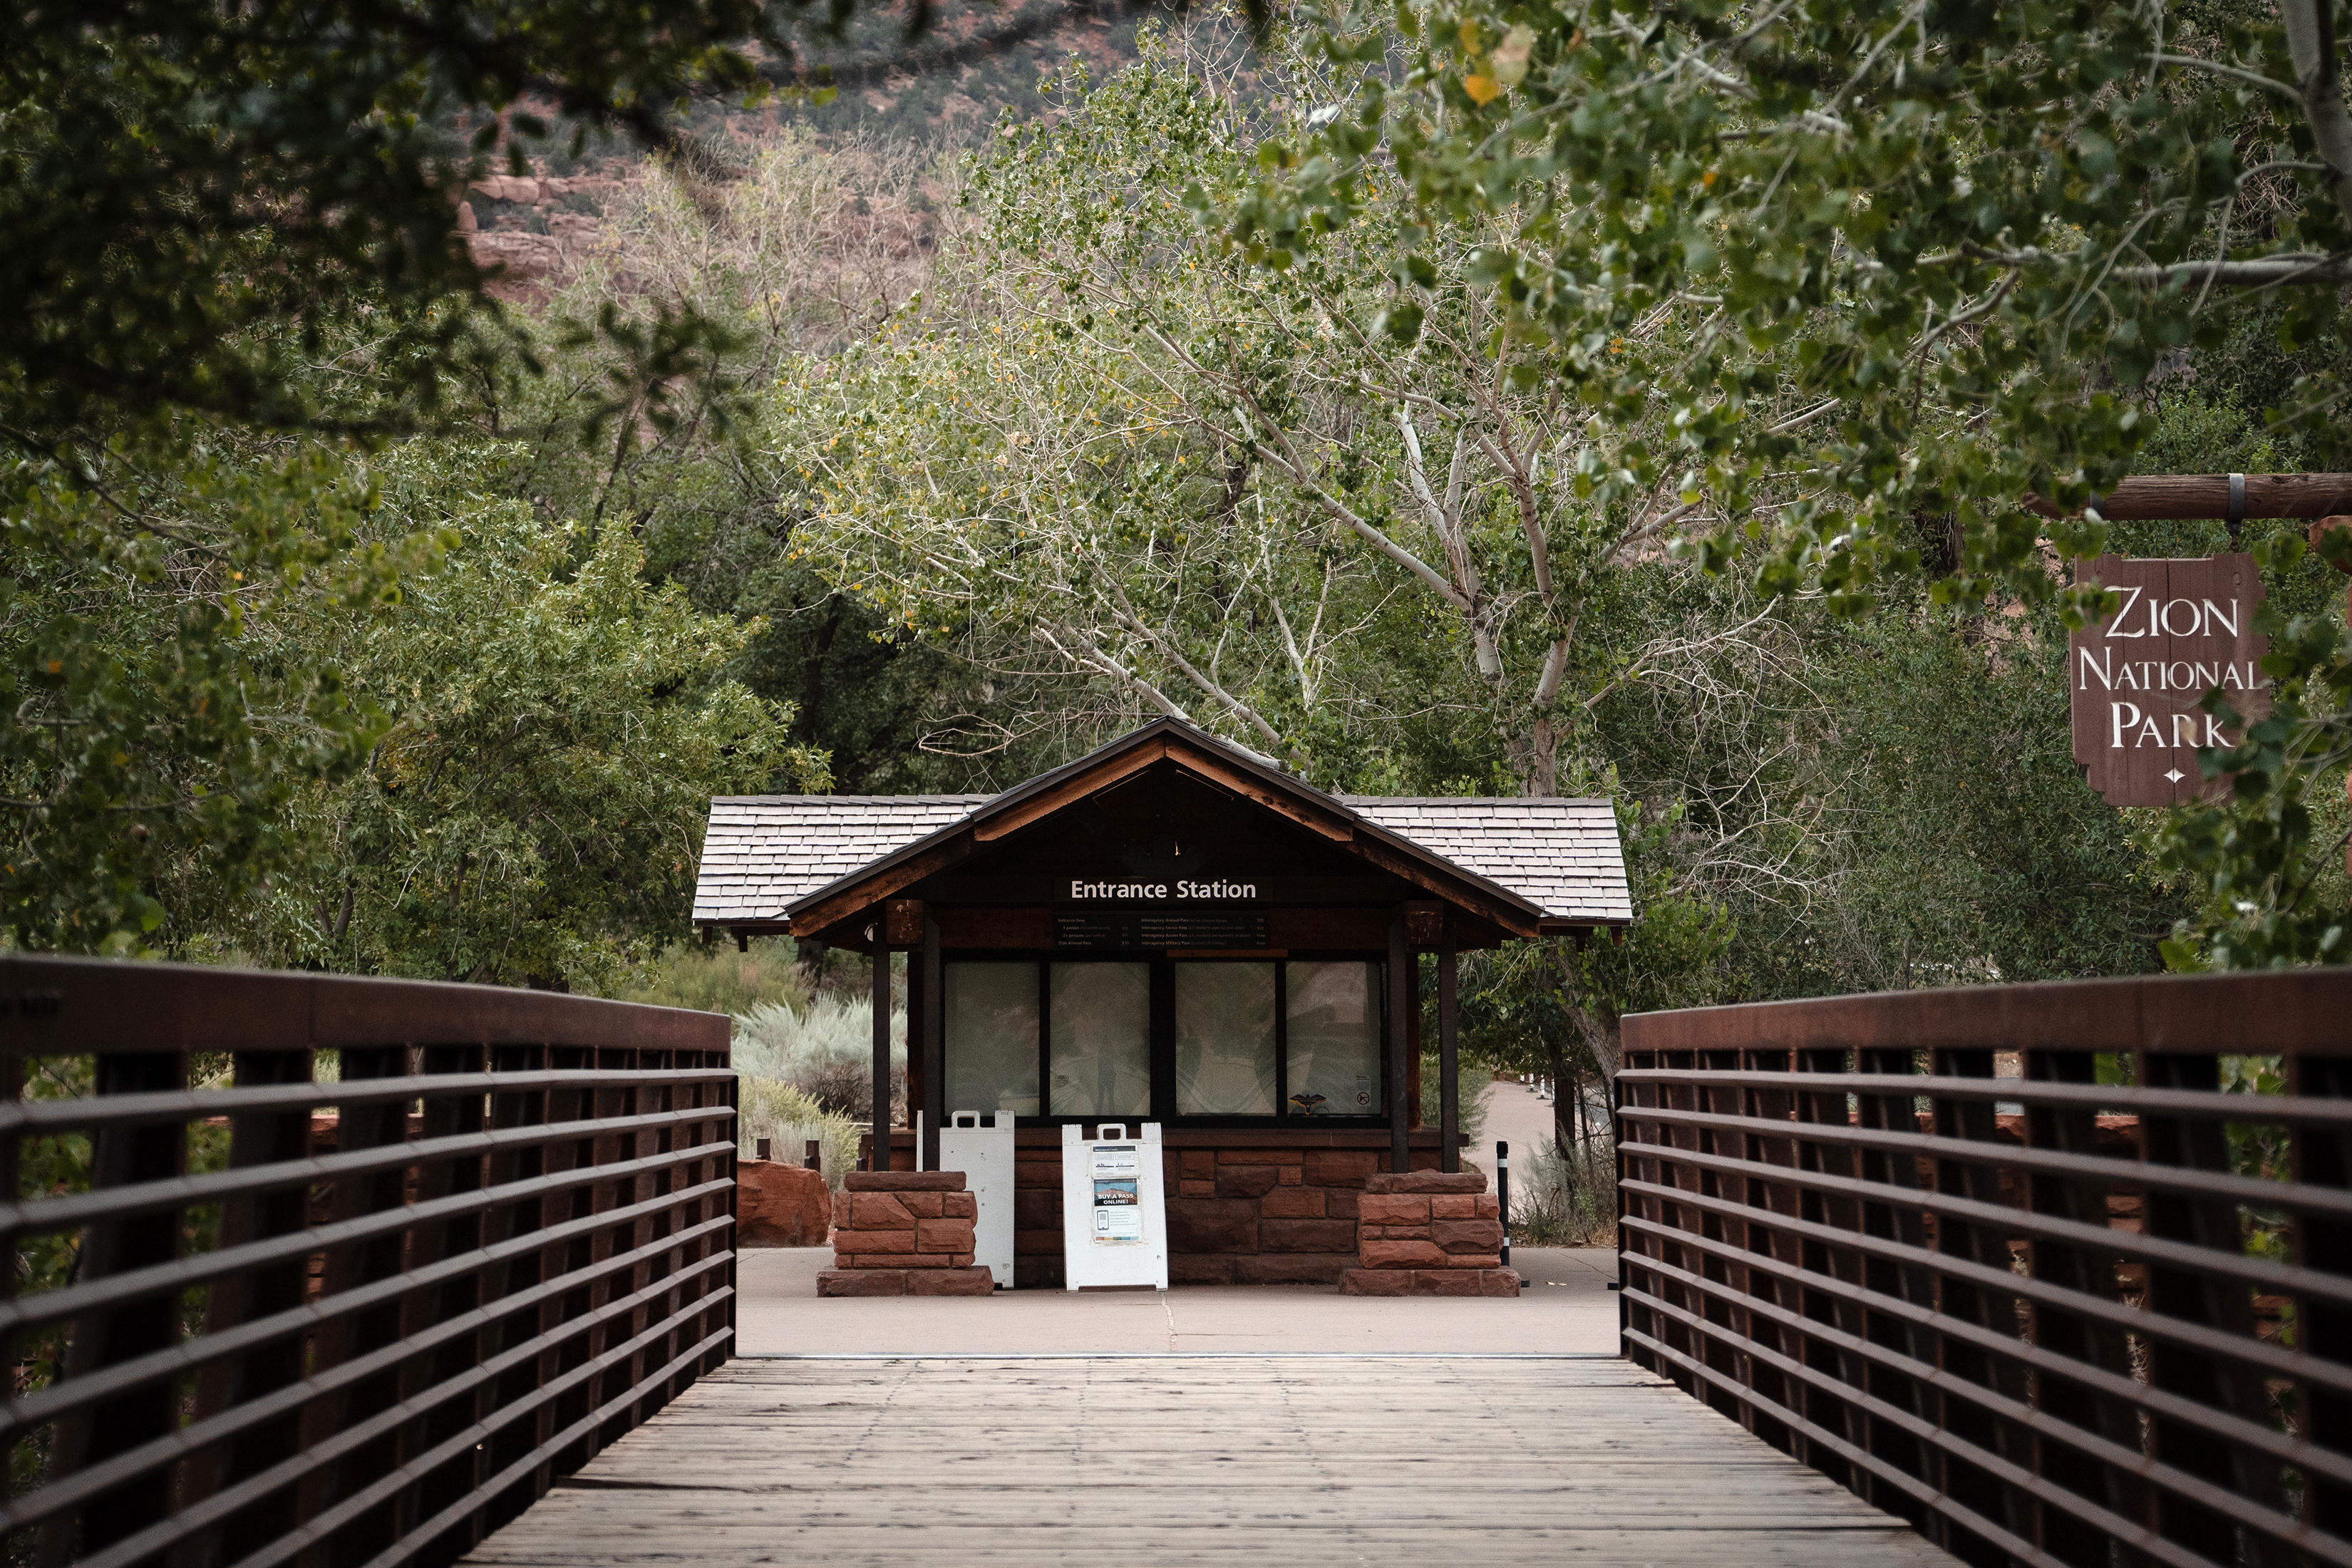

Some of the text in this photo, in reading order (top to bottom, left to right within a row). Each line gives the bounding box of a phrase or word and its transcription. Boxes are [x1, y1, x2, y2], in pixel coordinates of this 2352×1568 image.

[2104, 585, 2239, 638] ZION
[2078, 646, 2265, 691] NATIONAL
[2110, 701, 2237, 748] PARK
[1071, 879, 1256, 898] Entrance Station
